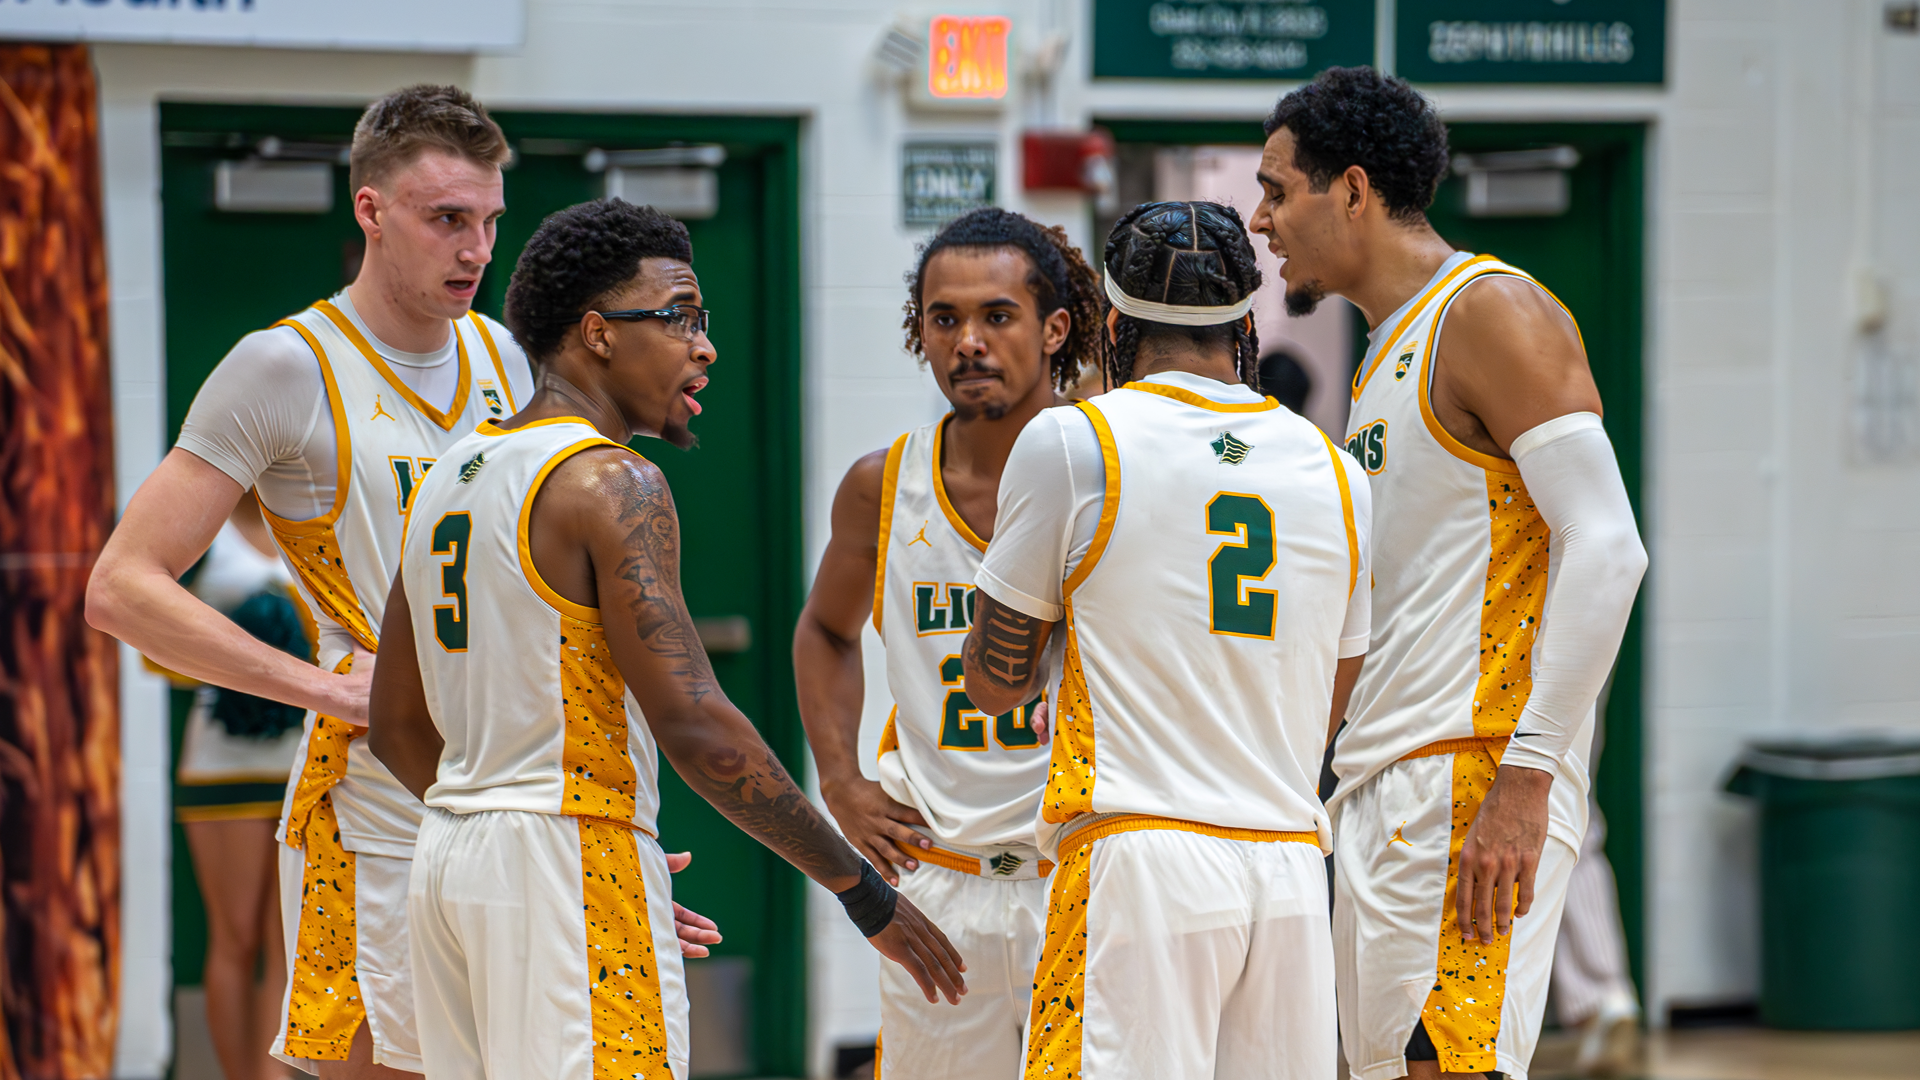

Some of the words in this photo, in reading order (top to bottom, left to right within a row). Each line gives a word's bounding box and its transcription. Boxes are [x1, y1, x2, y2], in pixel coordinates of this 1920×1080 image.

[931, 17, 1010, 97] EXIT
[1343, 418, 1388, 476] ONS
[430, 510, 473, 653] 3
[1205, 491, 1278, 641] 2
[912, 581, 976, 637] LI
